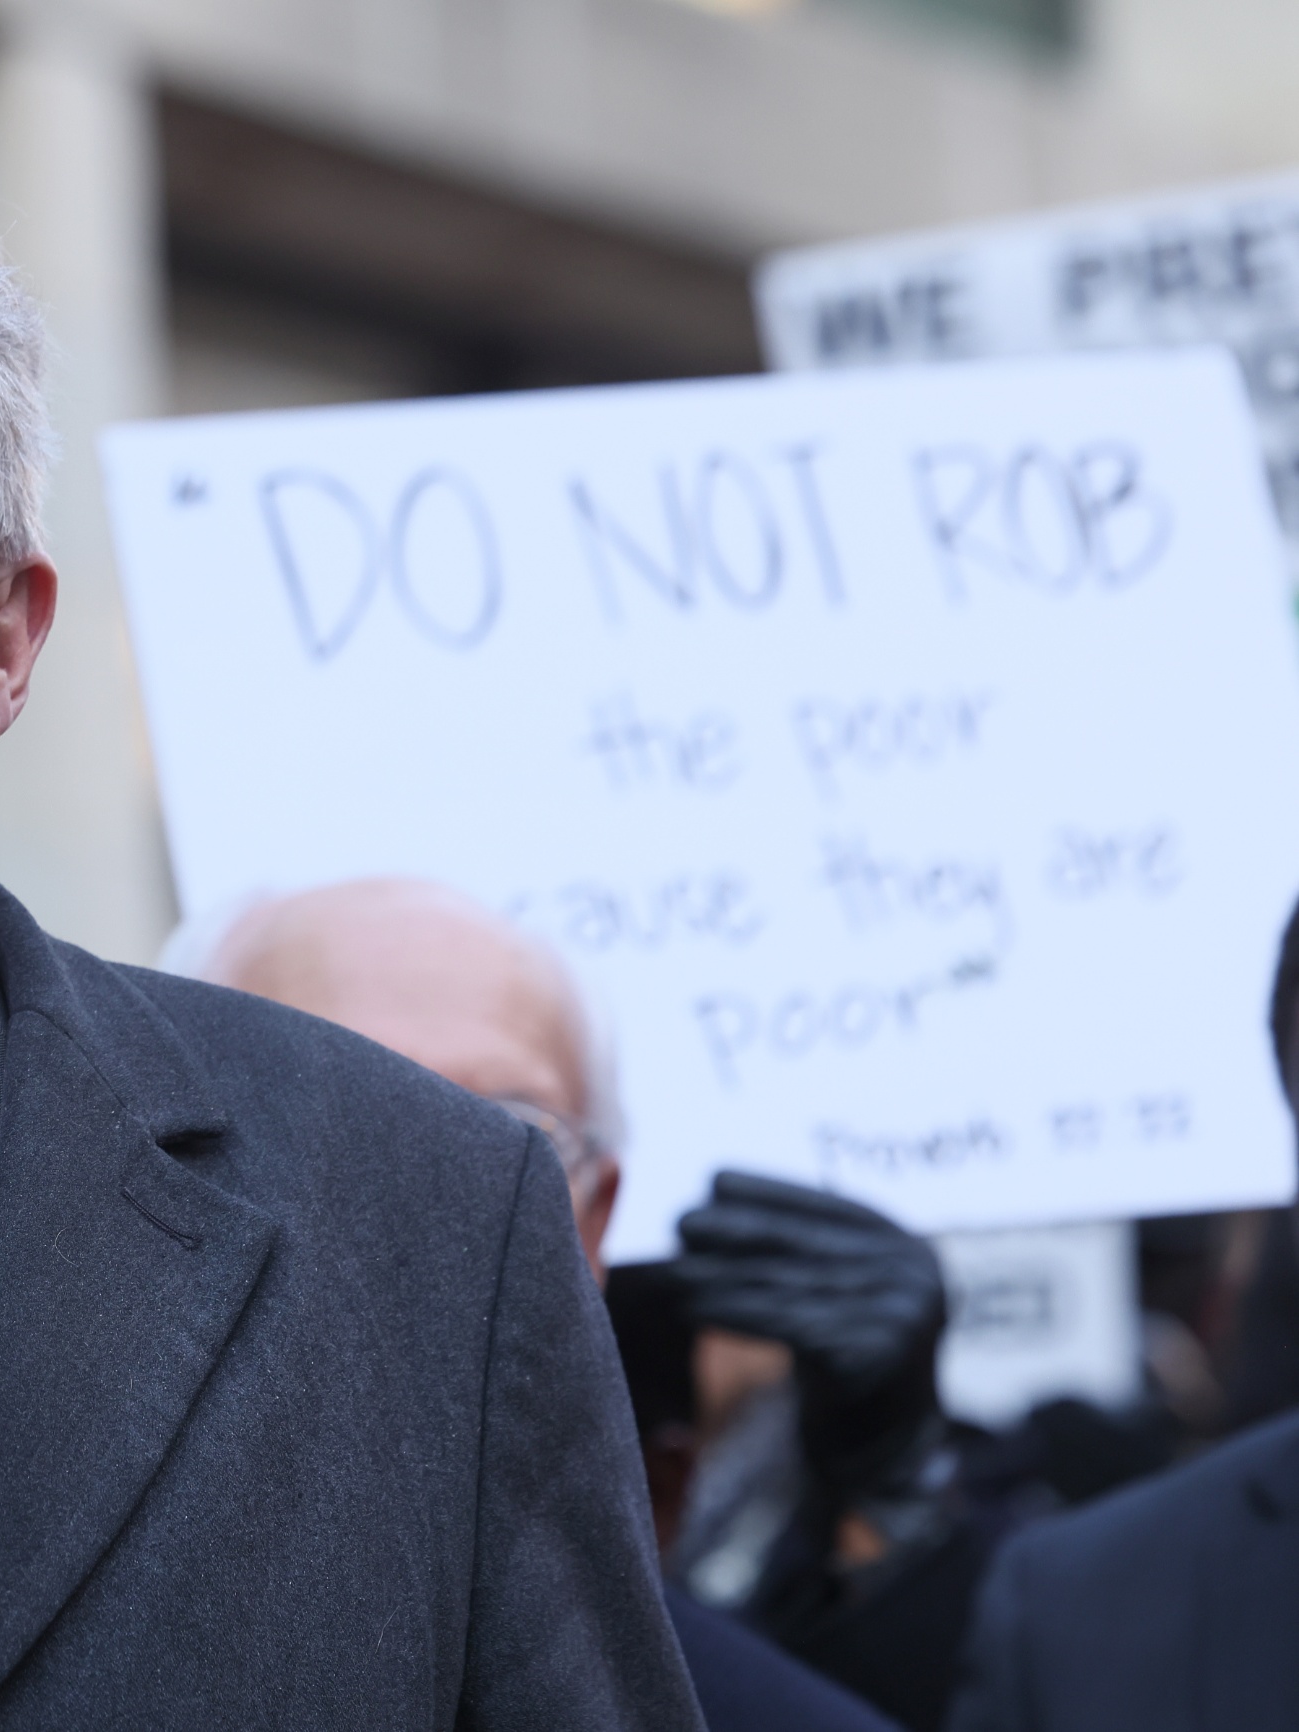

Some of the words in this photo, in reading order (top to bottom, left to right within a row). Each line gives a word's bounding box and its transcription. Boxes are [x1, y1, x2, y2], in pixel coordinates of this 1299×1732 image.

[1054, 208, 1299, 330] PRE
[566, 437, 849, 624] NOT
[910, 438, 1175, 606] ROB
[583, 690, 742, 791] the
[791, 688, 994, 808] poor
[816, 830, 1018, 955] they
[1046, 824, 1184, 902] are
